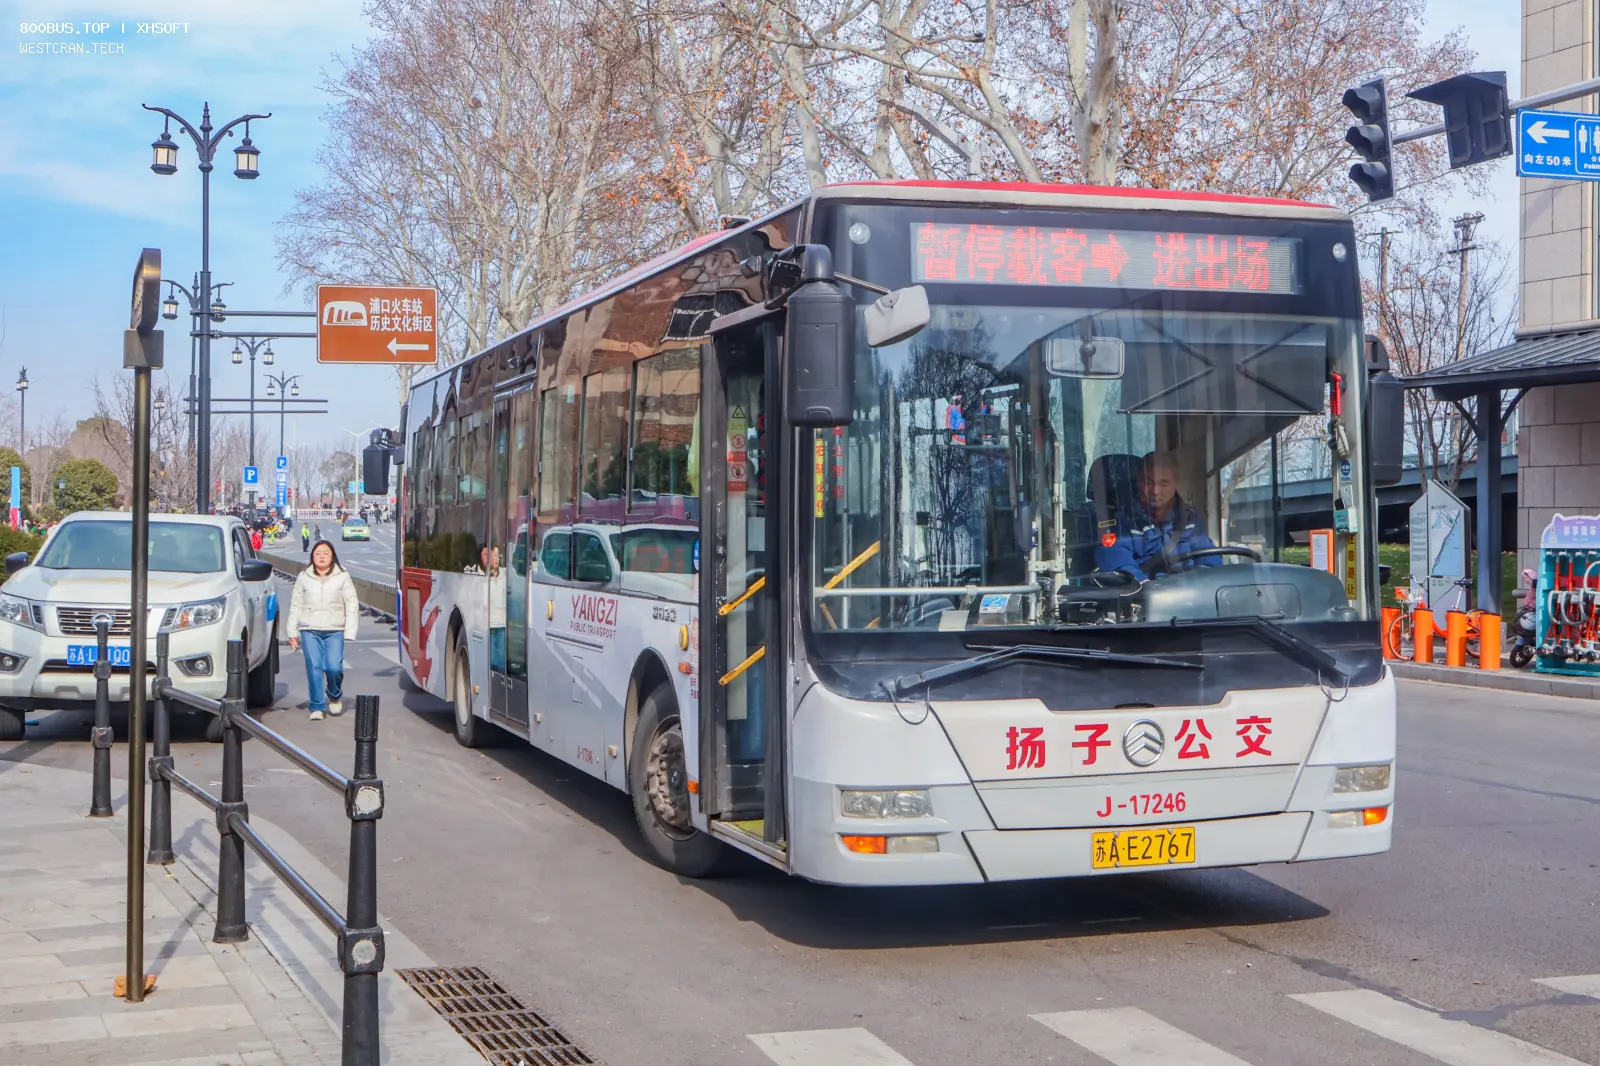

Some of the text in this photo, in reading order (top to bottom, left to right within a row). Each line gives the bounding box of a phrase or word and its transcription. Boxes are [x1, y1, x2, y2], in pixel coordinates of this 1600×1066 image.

[1524, 153, 1572, 167] 向左50米
[918, 222, 1270, 290] 暂停载客 进出场
[369, 297, 423, 315] 浦口火车站
[369, 315, 434, 332] 历史文化街区
[571, 593, 619, 627] YANGZI
[570, 620, 617, 640] PUBLIC TRANSPORT
[1096, 791, 1187, 818] J-17246
